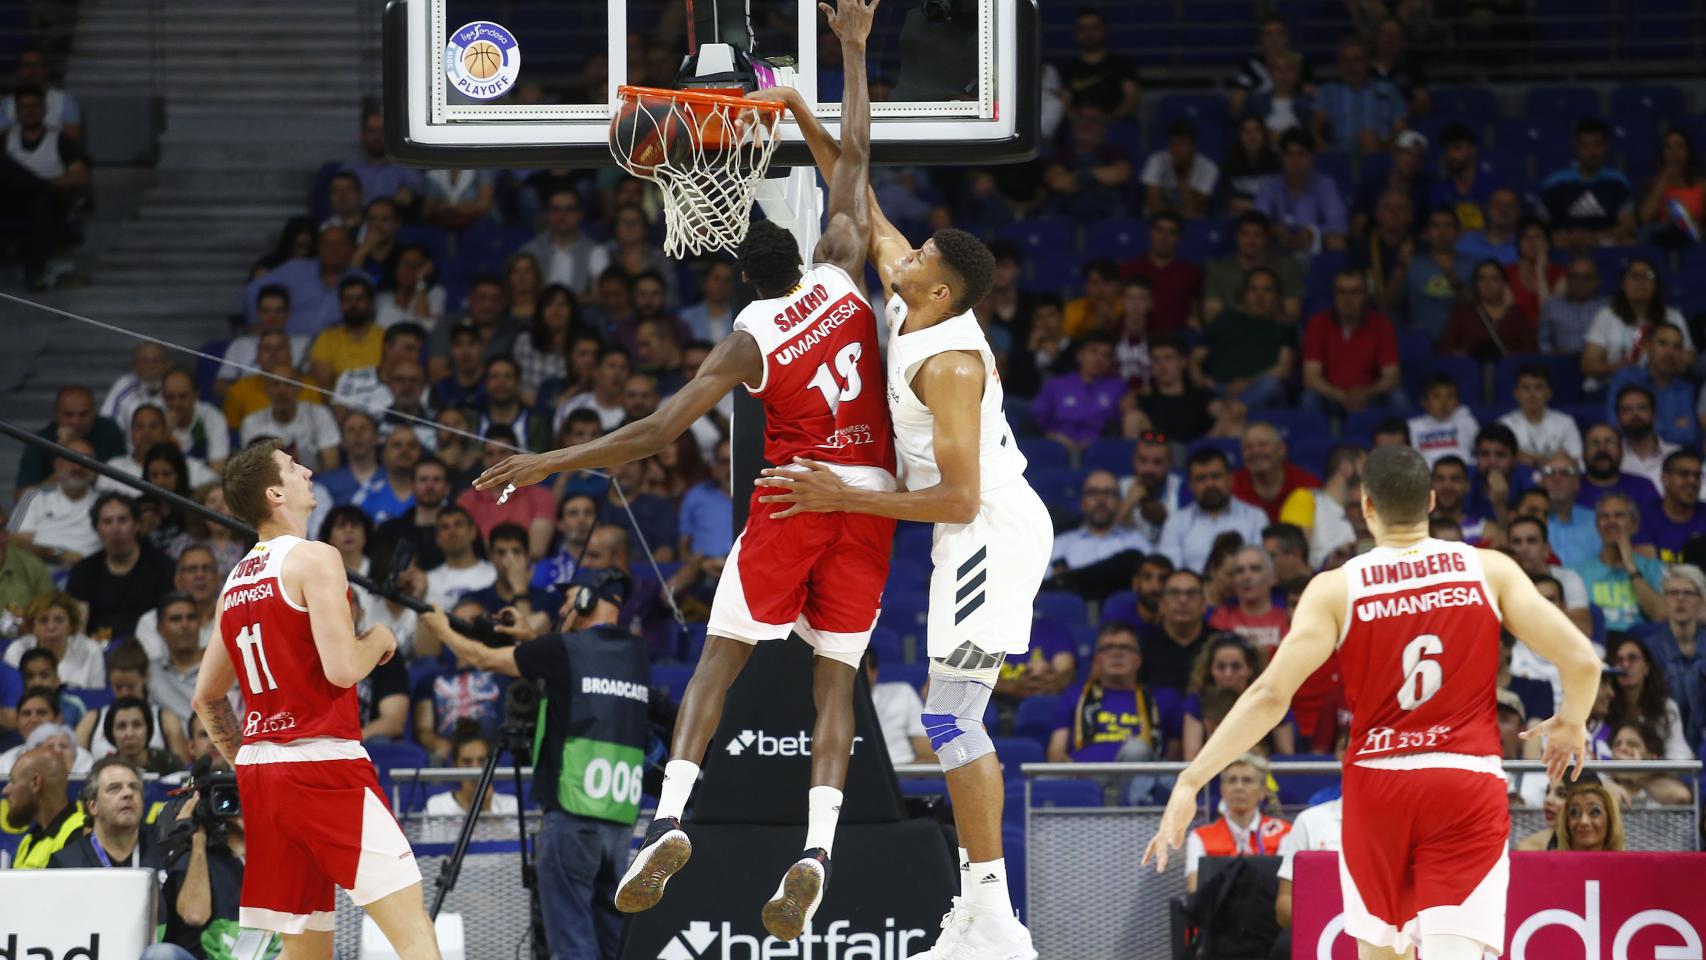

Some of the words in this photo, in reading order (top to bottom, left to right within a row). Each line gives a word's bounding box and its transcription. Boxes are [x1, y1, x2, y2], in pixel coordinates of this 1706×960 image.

[458, 75, 509, 95] PLAYOFF
[773, 283, 829, 333] SAKHO
[775, 300, 861, 366] UMANRESA
[1361, 552, 1466, 587] LUNDBERG
[1357, 587, 1483, 622] UMANRESA
[236, 622, 278, 695] 11
[1397, 634, 1443, 711] 6
[757, 730, 863, 756] betr
[584, 757, 644, 806] 006
